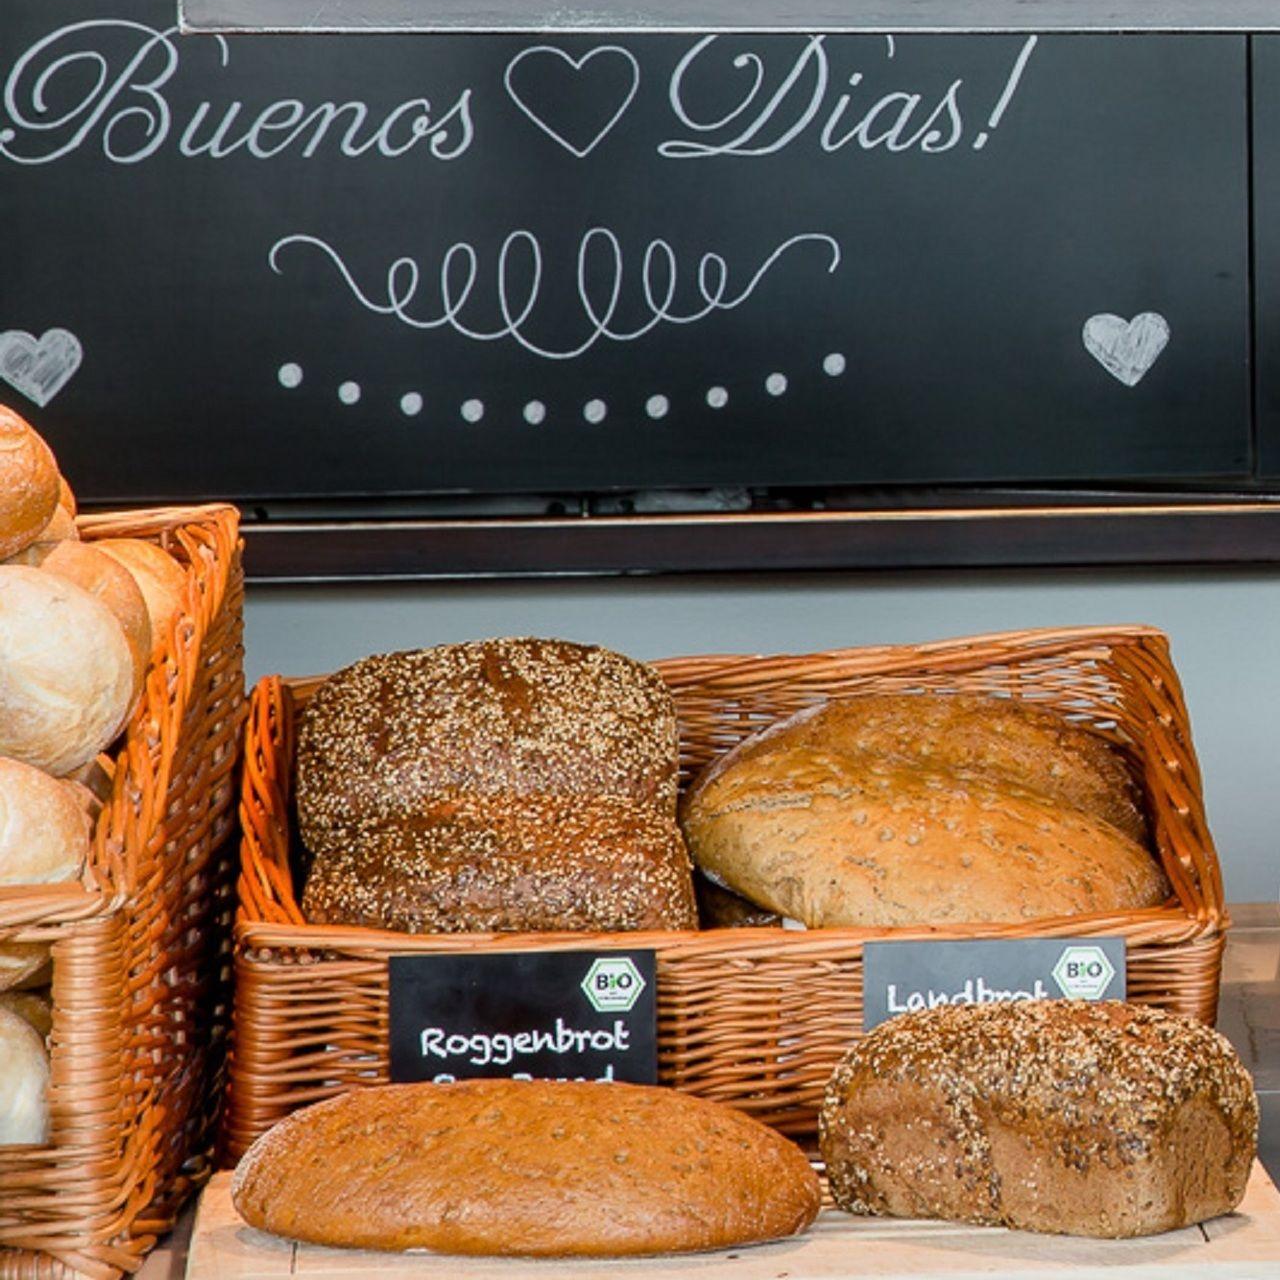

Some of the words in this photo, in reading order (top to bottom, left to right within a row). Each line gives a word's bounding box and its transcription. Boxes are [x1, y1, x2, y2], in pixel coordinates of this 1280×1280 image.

[2, 20, 476, 164] Buenos
[657, 34, 1038, 159] Dias!
[420, 1017, 630, 1065] Roggenbrot
